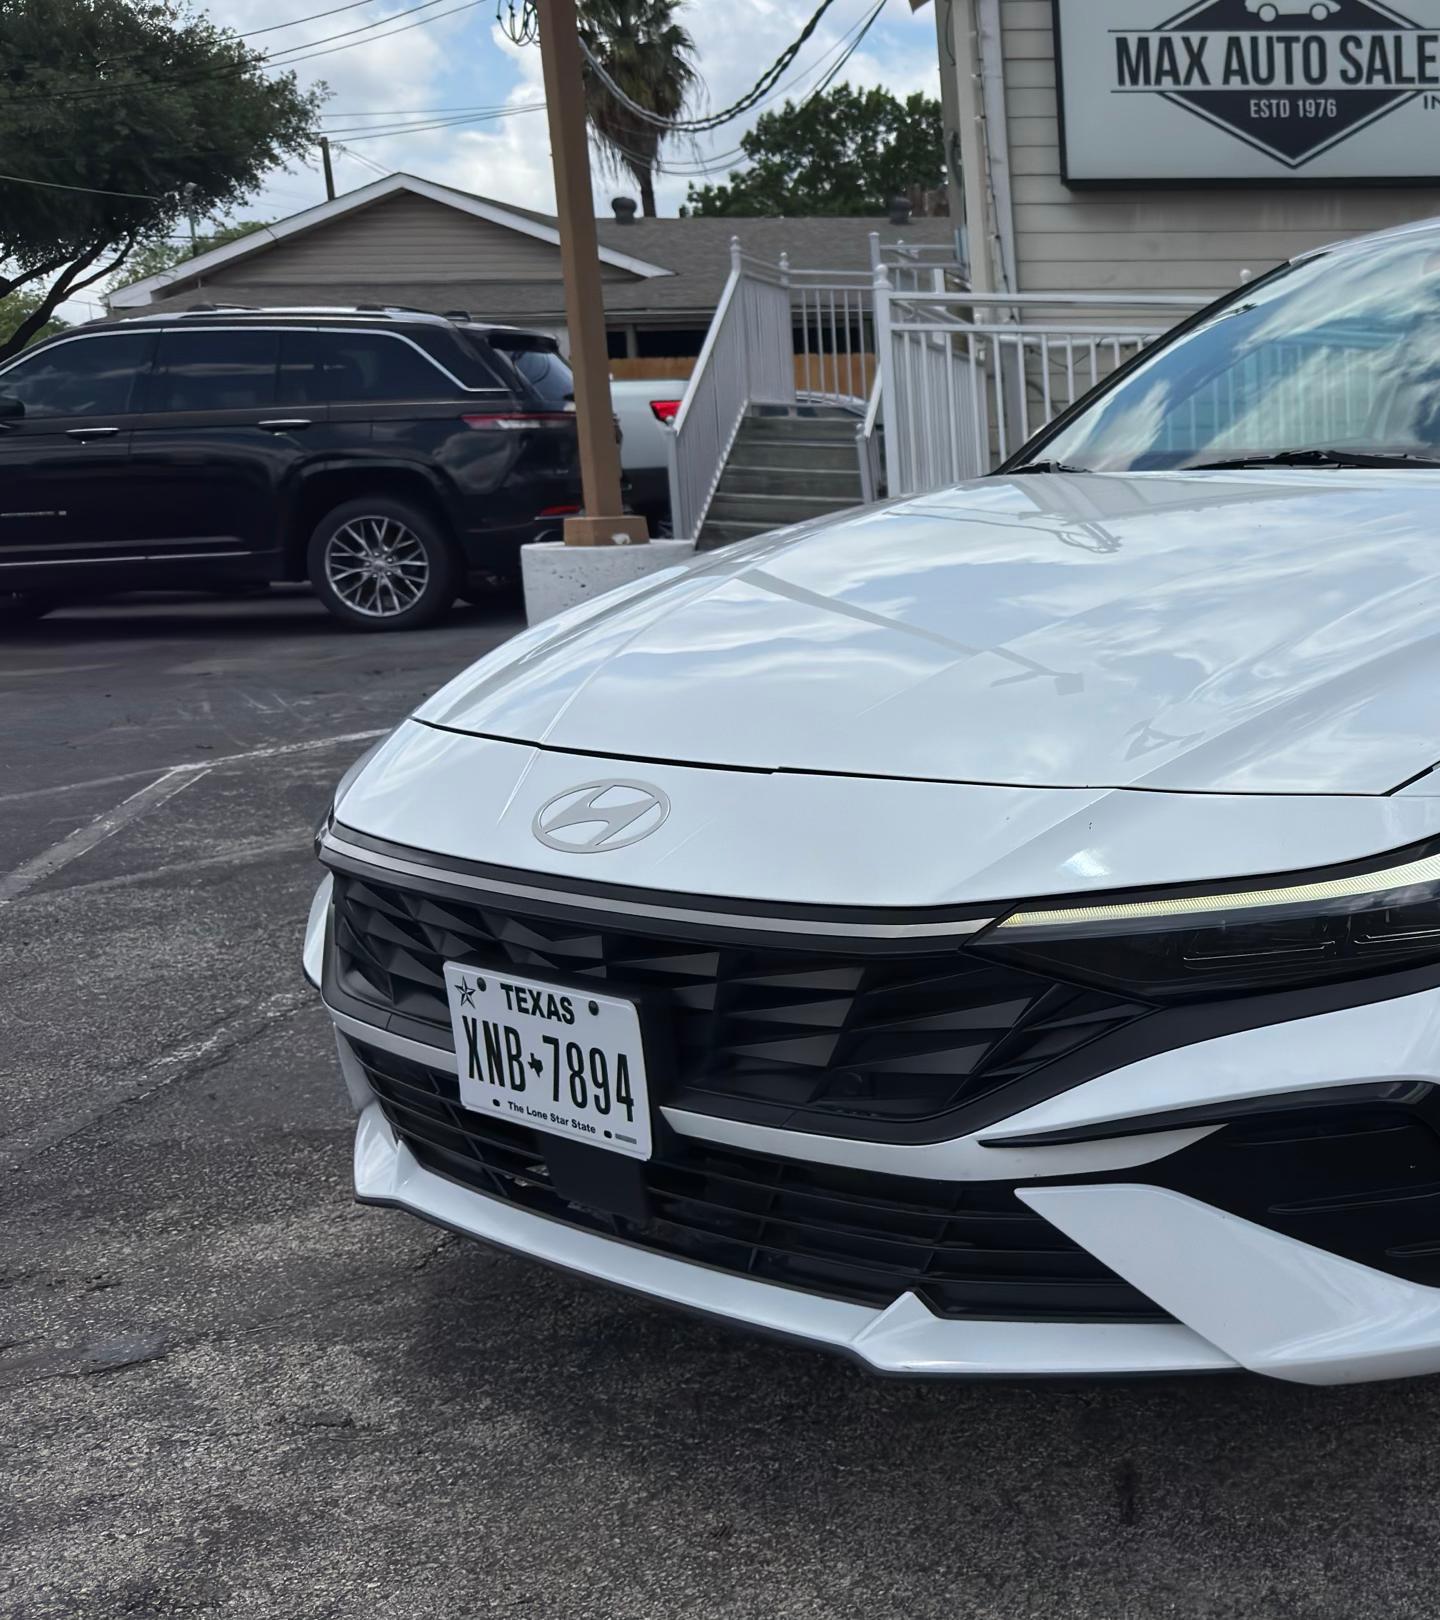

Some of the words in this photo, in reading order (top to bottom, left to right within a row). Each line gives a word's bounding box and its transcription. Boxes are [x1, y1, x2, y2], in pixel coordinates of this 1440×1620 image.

[1115, 36, 1211, 86] MAX
[1222, 35, 1328, 86] AUTO
[1250, 98, 1290, 118] ESTD
[1297, 98, 1337, 118] 1976
[500, 983, 575, 1025] TEXAS
[507, 1101, 524, 1114] The
[527, 1106, 548, 1120] Lone
[550, 1113, 569, 1126] Star
[571, 1119, 596, 1134] State
